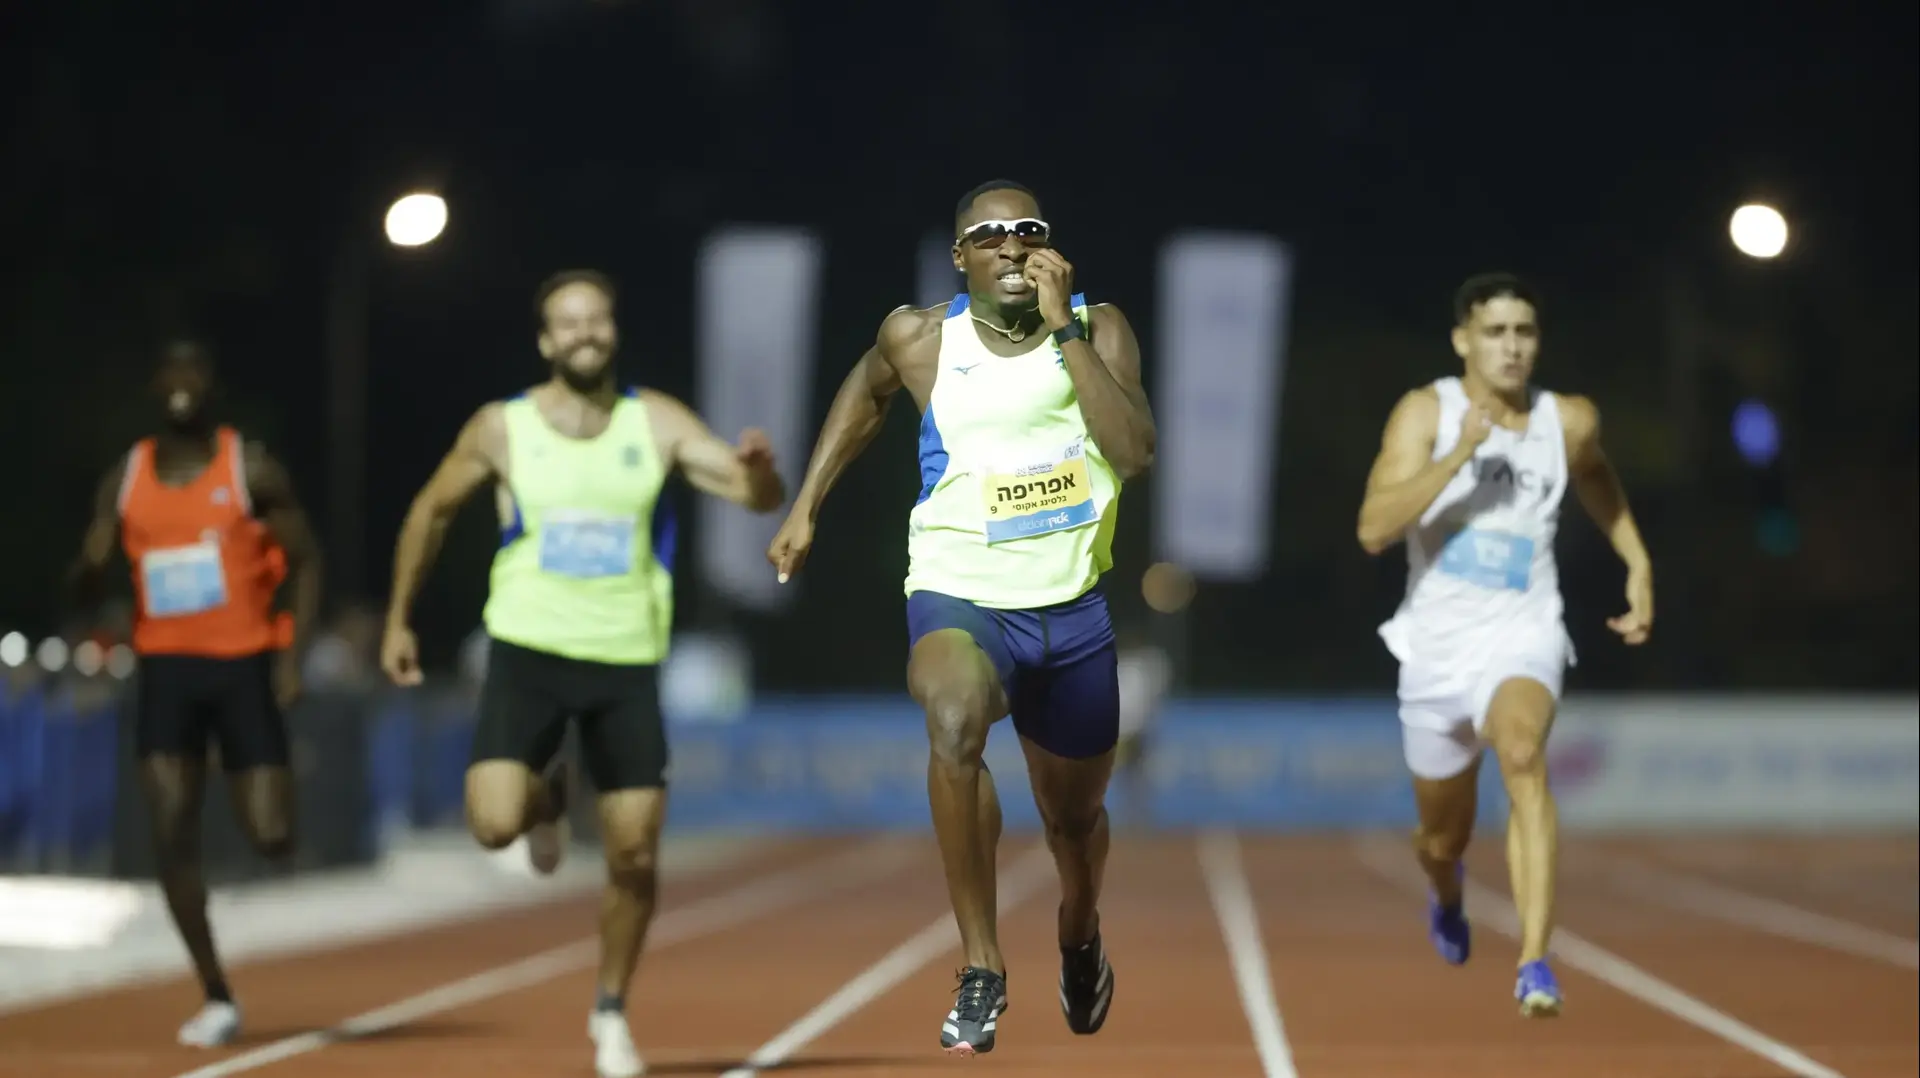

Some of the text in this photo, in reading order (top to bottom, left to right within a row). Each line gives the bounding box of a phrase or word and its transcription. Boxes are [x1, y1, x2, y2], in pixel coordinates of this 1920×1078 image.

[997, 473, 1076, 502] אפריפה
[990, 505, 998, 515] 9
[1012, 495, 1067, 512] בלסינג אקוסי
